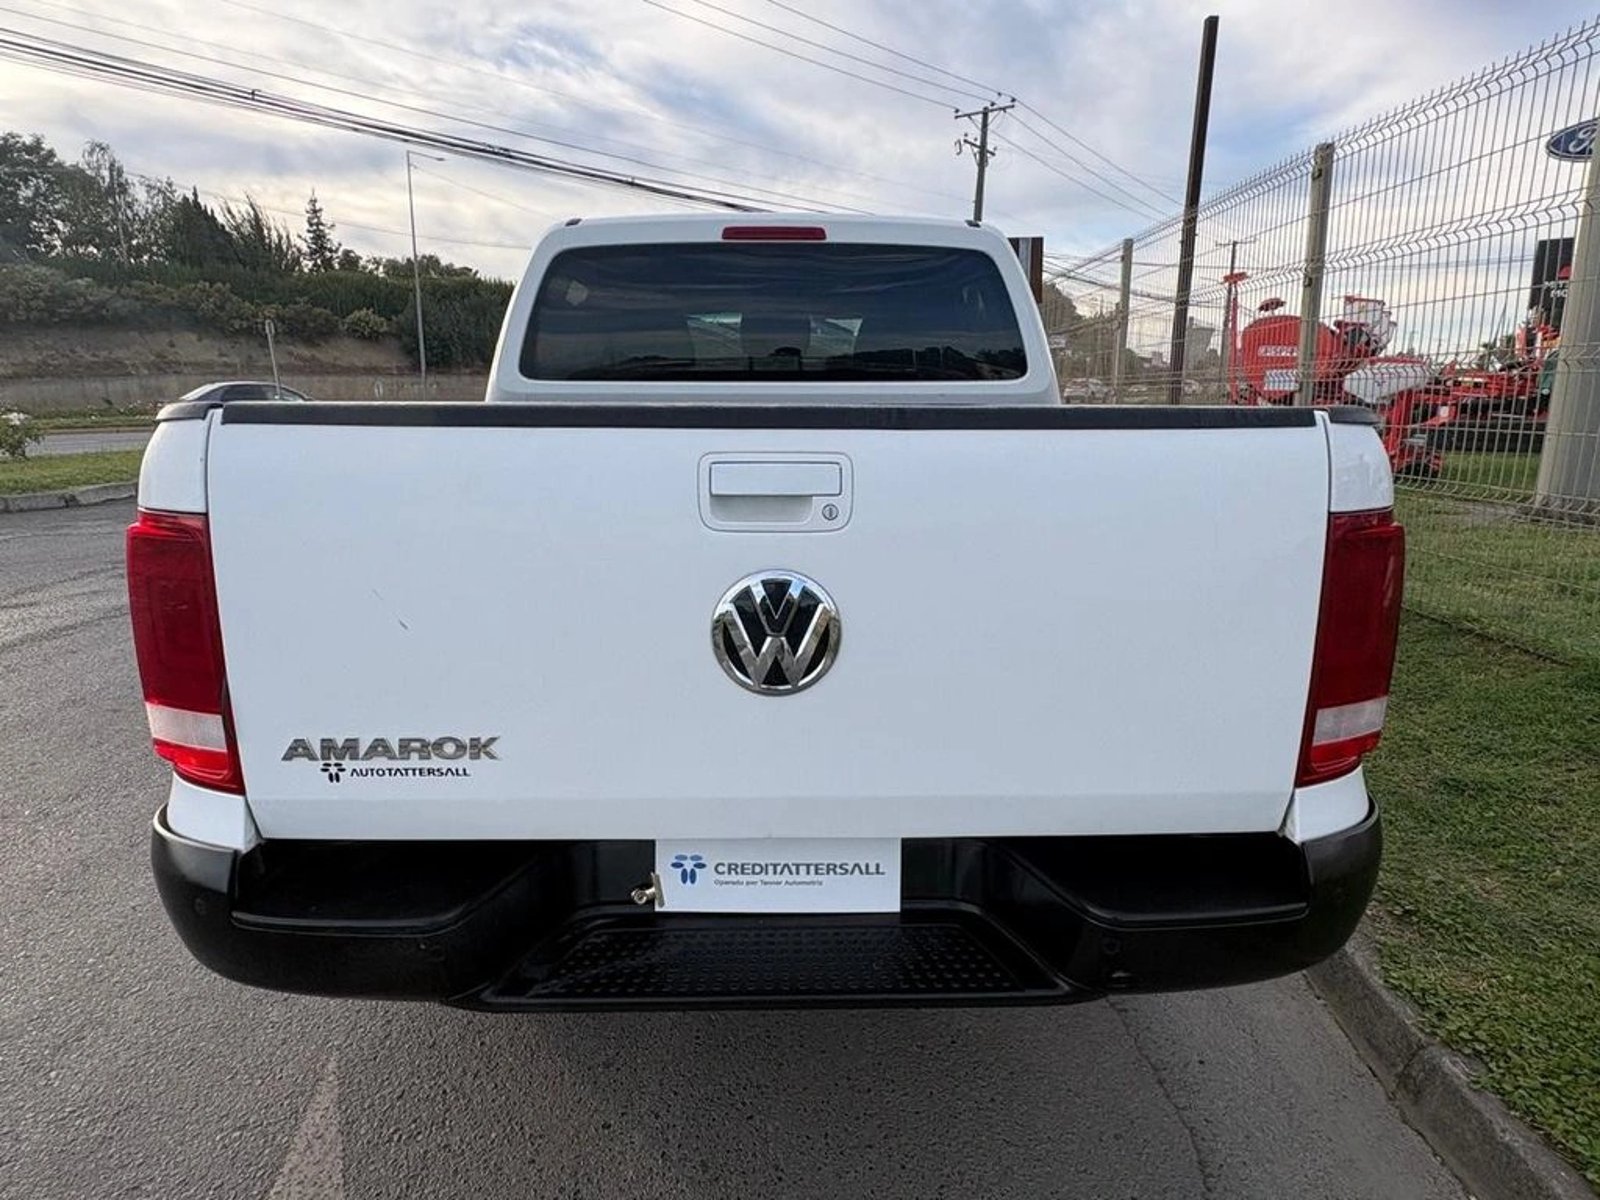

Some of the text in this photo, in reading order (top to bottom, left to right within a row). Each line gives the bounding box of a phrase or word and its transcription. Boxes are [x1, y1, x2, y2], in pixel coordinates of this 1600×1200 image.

[282, 736, 499, 761] AMAROK
[350, 767, 470, 778] AUTOTATTERSALL
[714, 862, 885, 876] CREDITATTERSALL
